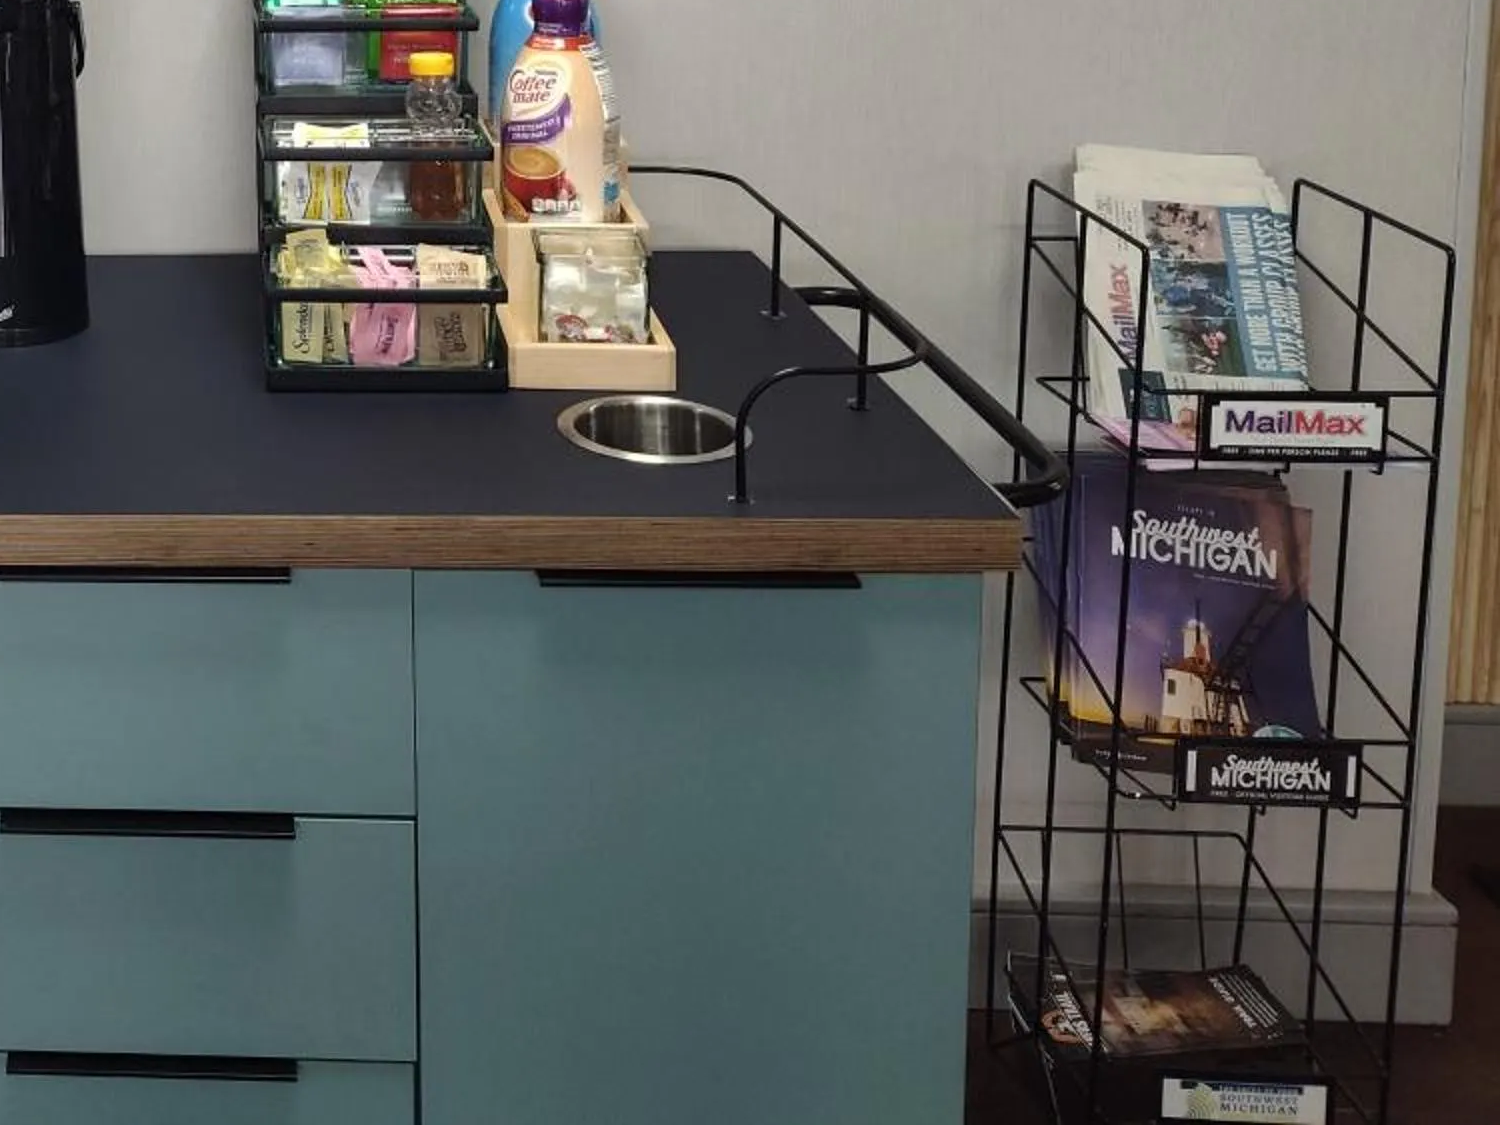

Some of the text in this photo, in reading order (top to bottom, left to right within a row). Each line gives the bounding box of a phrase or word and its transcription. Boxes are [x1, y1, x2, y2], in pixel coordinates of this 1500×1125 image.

[510, 69, 557, 94] Coffee
[512, 90, 550, 104] mate
[1226, 212, 1278, 373] GET MORE THAN A WORKOUT
[1109, 263, 1138, 363] MailMax
[1225, 409, 1366, 435] MailMax
[1132, 509, 1263, 551] Southwest
[1111, 525, 1278, 580] MICHIGAN
[1222, 754, 1321, 775] Southwest
[1211, 766, 1332, 792] MICHIGAN
[1219, 1103, 1298, 1115] MICHIGAN
